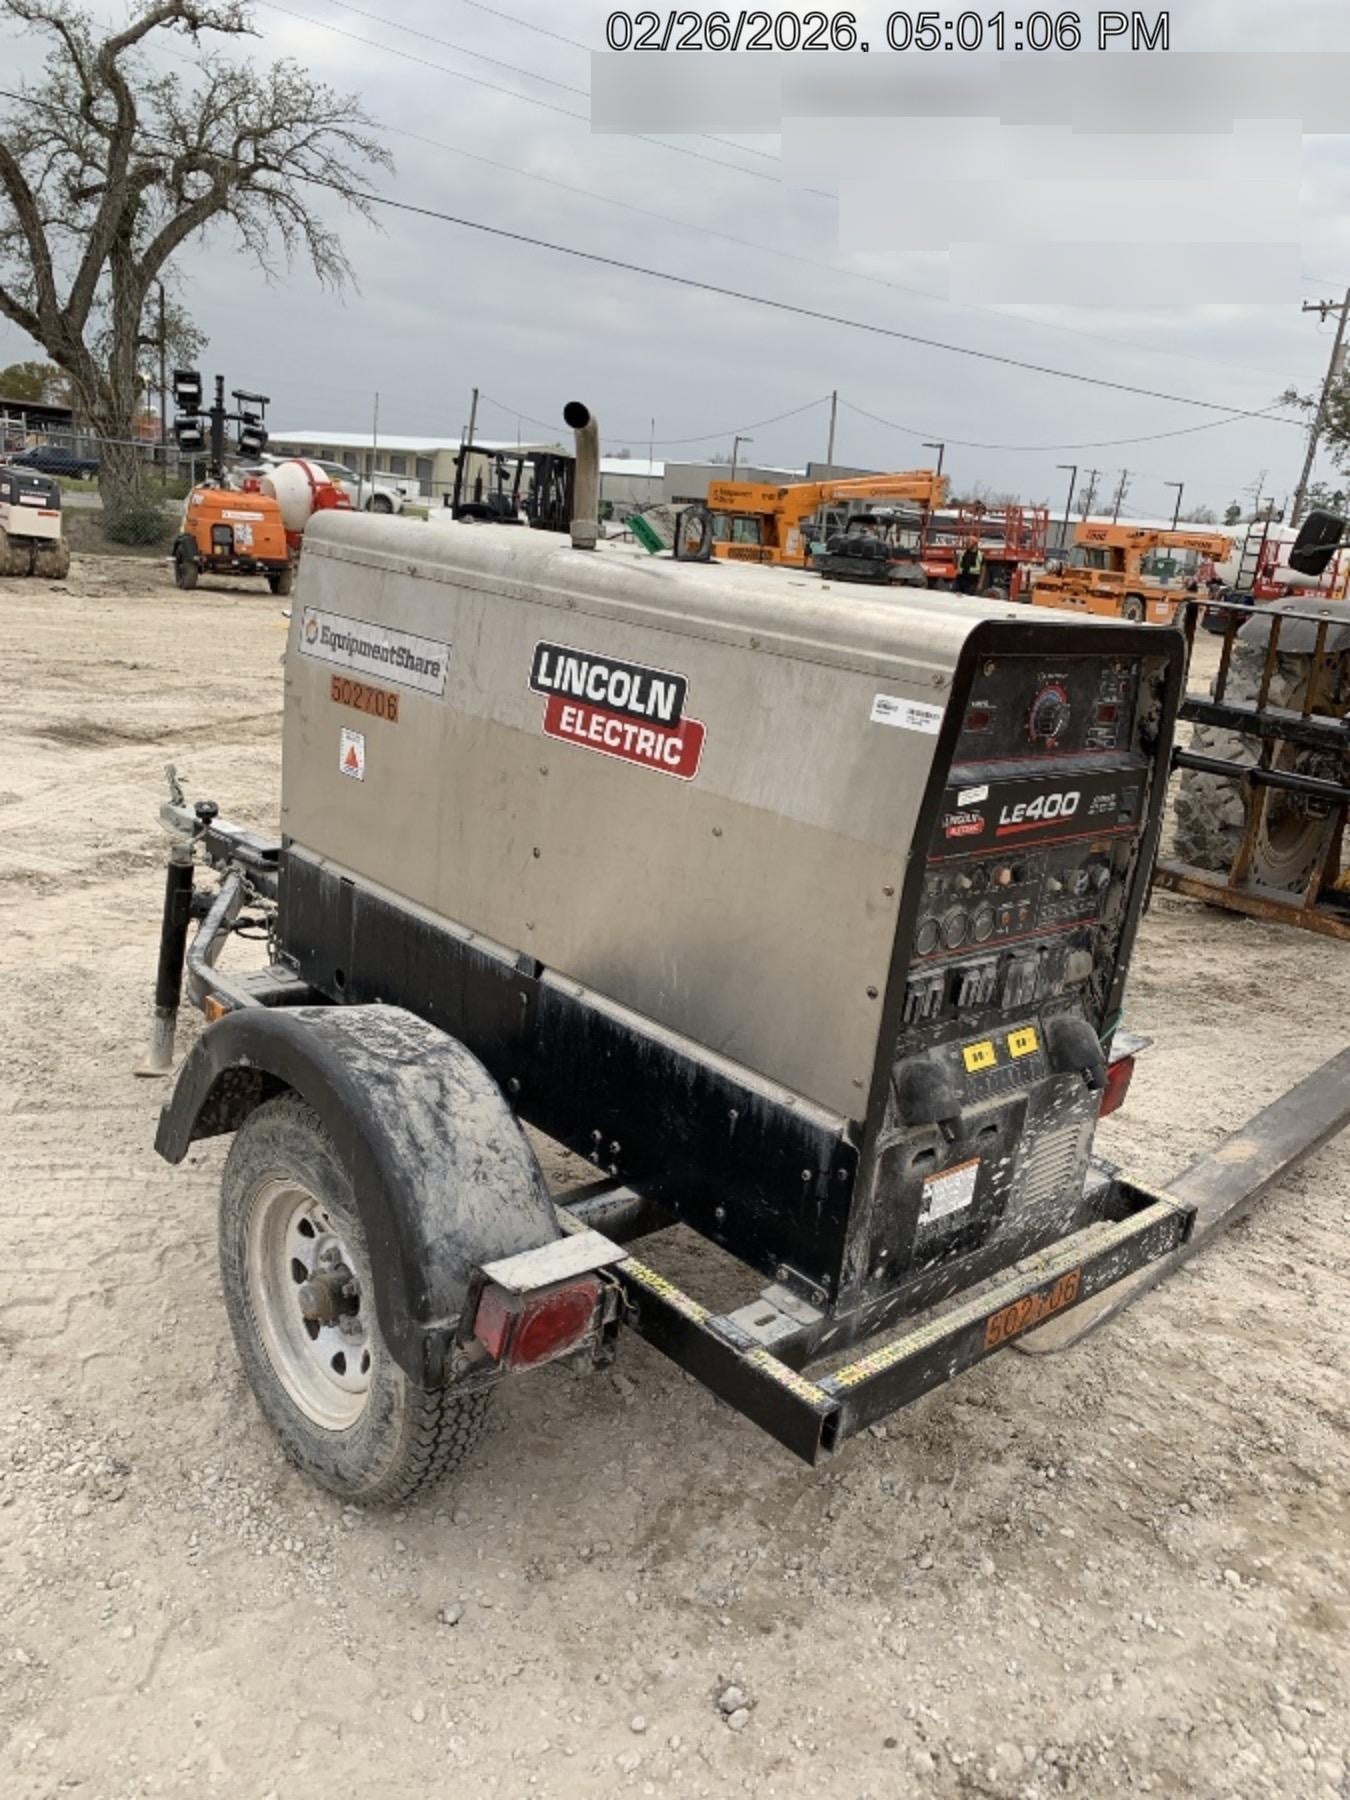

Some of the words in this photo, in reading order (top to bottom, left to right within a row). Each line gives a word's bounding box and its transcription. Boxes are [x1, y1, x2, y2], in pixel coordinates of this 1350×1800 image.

[319, 624, 441, 678] EquipmentShare
[331, 676, 398, 721] 502706
[536, 650, 677, 721] LINCOLN
[558, 704, 684, 766] ELECTRIC
[999, 791, 1081, 825] LE400
[986, 1273, 1078, 1345] 50206
